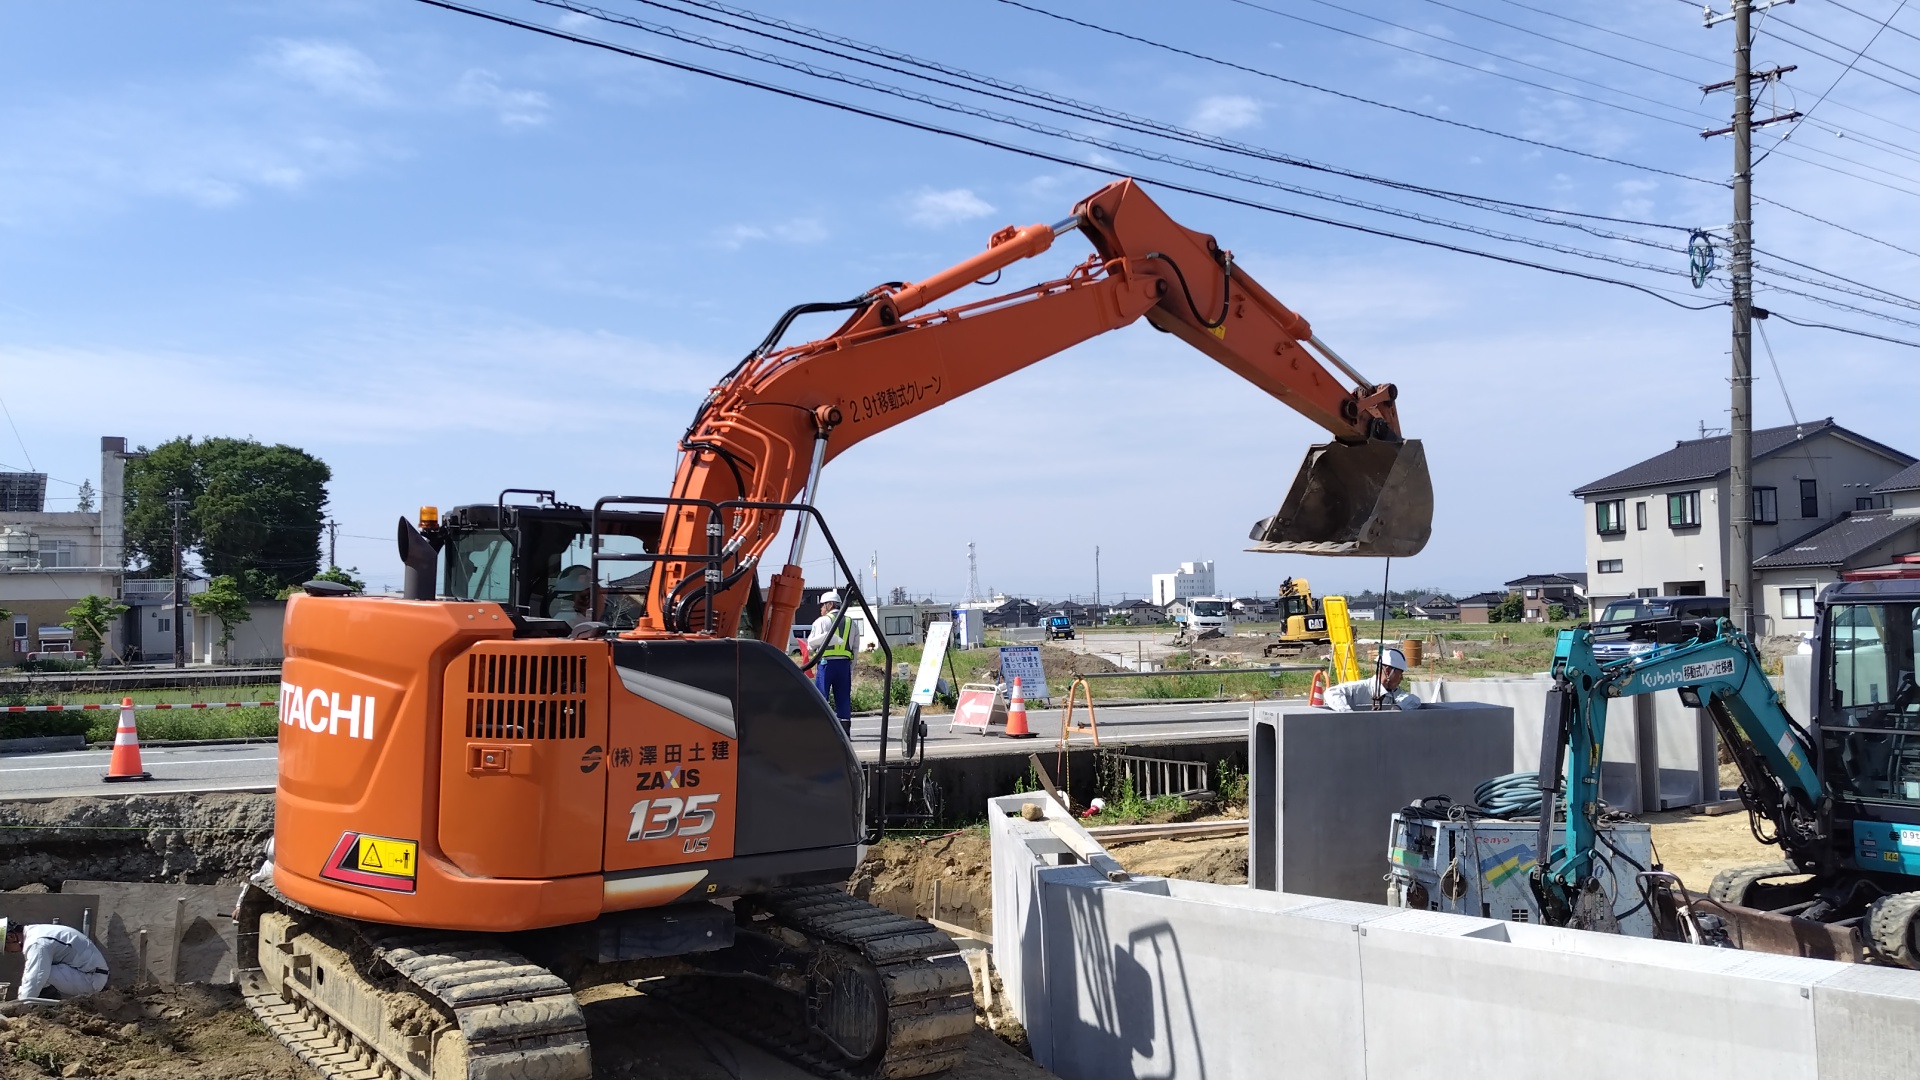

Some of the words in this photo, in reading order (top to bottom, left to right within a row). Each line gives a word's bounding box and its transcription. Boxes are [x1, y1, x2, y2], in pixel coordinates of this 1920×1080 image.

[849, 376, 942, 423] 2.9t移動式クレーン
[1308, 618, 1324, 629] CAT
[1641, 668, 1683, 687] Kubota
[279, 680, 375, 740] ITACHI
[636, 765, 700, 791] ZAXIS
[626, 793, 721, 841] 135
[682, 837, 710, 853] US
[1884, 852, 1898, 861] 144
